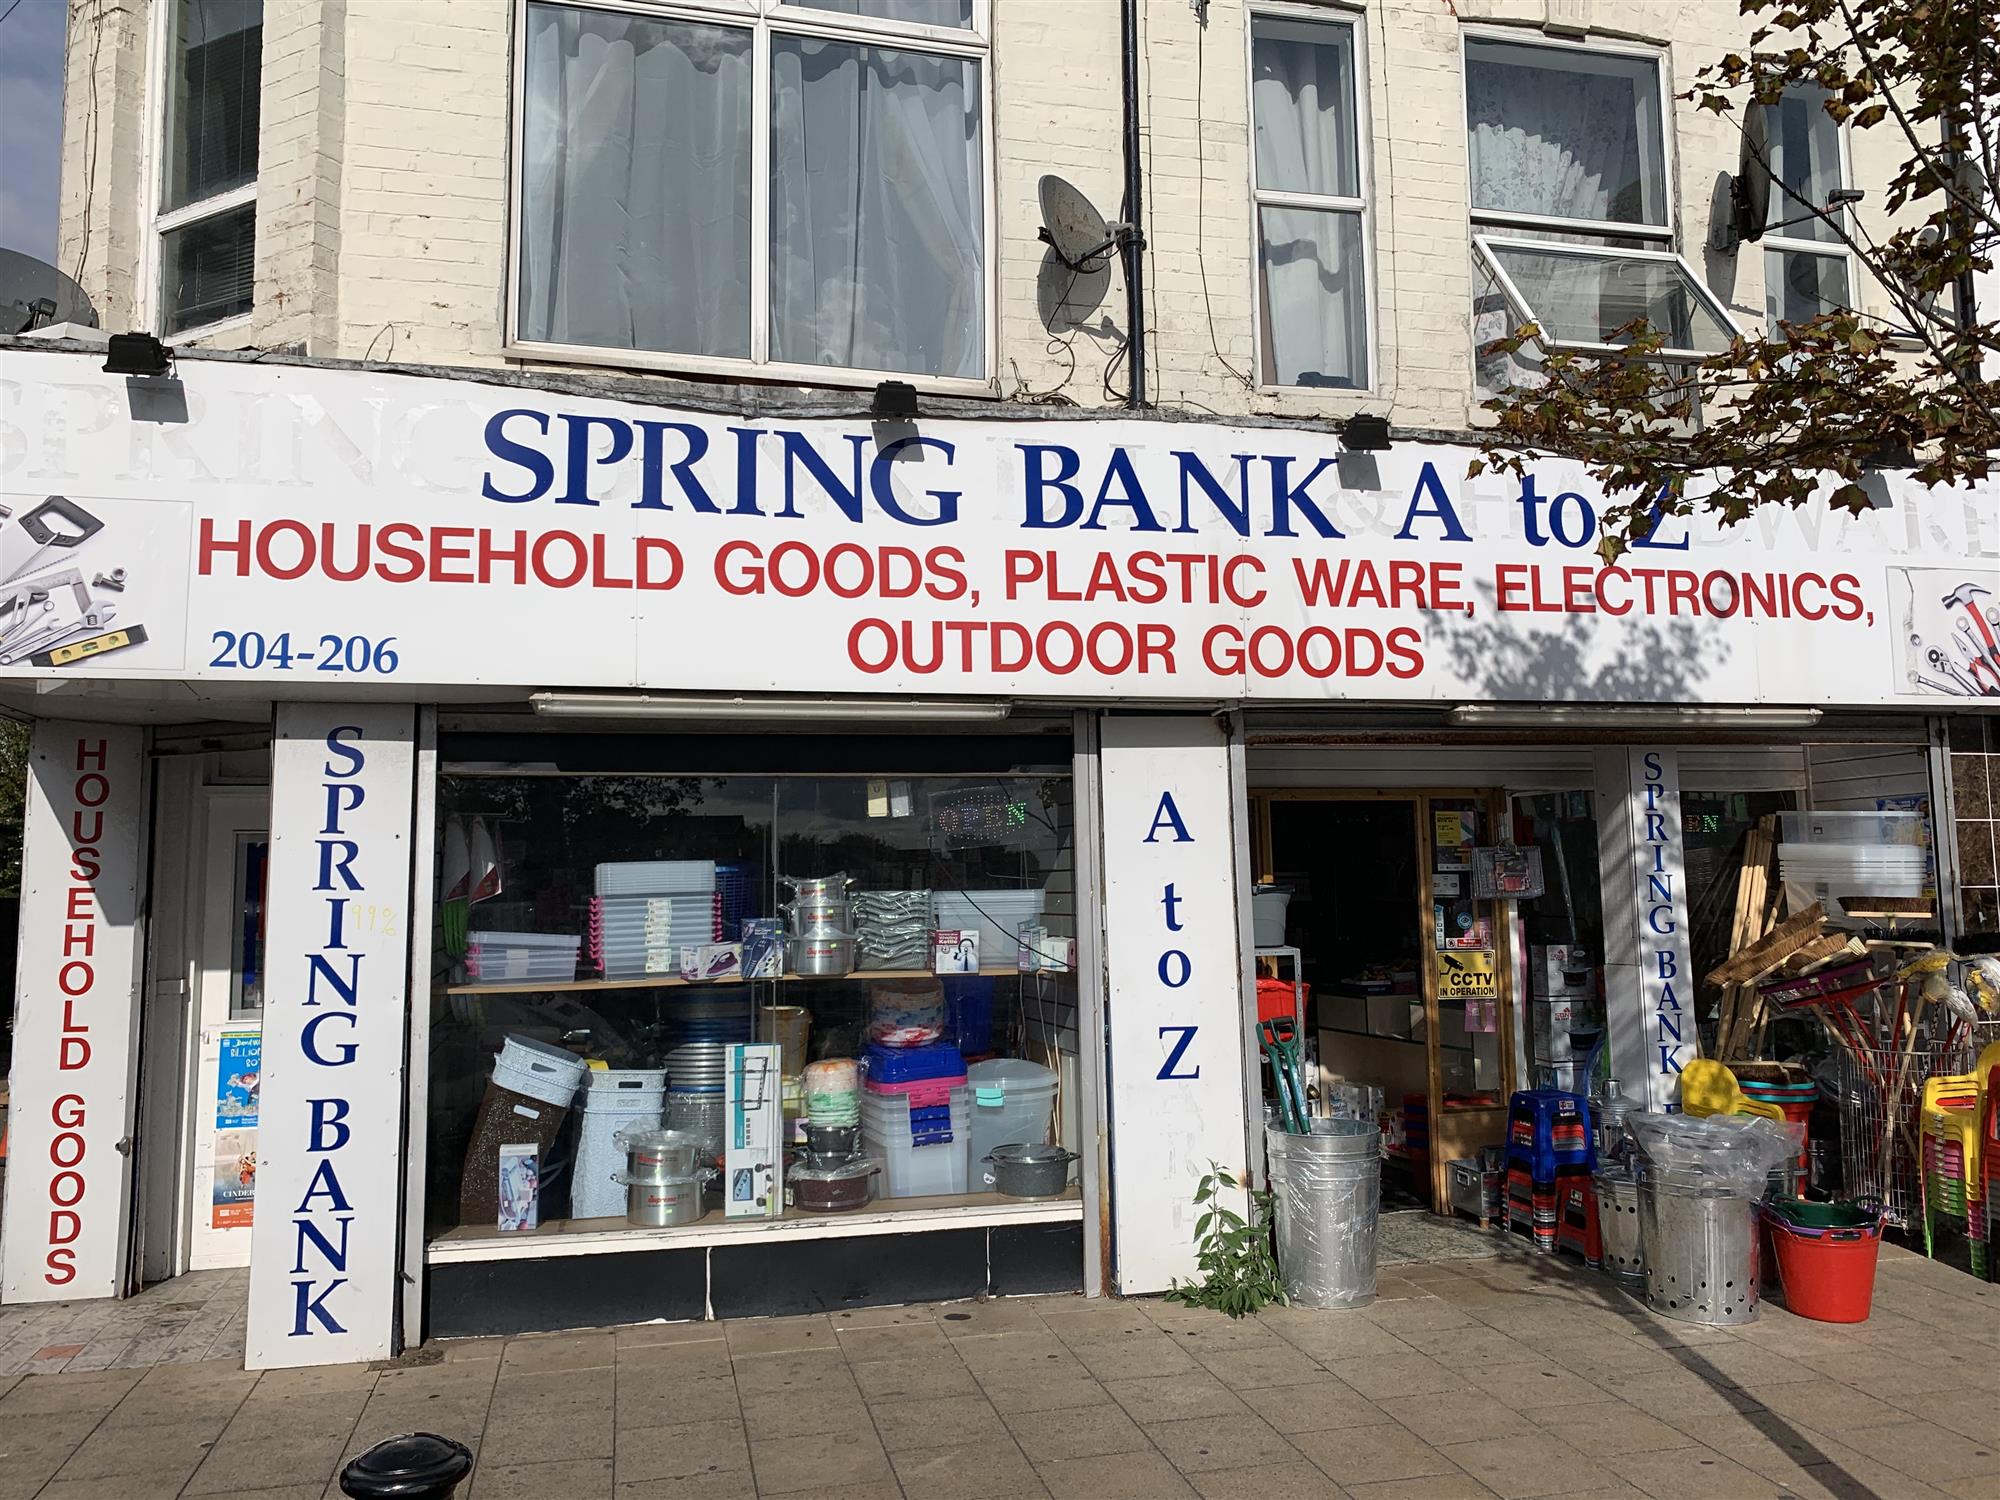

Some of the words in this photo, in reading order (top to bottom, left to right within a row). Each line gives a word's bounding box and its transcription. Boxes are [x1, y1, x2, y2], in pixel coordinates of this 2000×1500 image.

[482, 408, 963, 527] SPRING
[1017, 443, 1346, 540] BANK
[1395, 461, 1473, 542] A
[1517, 476, 1597, 549] to
[198, 517, 685, 591] HOUSEHOLD
[713, 539, 981, 608] GOODS,
[1005, 549, 1268, 608] PLASTIC
[1290, 557, 1475, 618] WARE,
[1495, 563, 1874, 627] ELECTRONICS,
[209, 630, 399, 673] 204-206
[847, 617, 1177, 676] OUTDOOR
[1201, 623, 1425, 680] GOODS
[1143, 791, 1196, 844] A
[1644, 751, 1676, 935] SPRING
[58, 739, 110, 1071] HOUSEHOLD
[300, 725, 366, 1068] SPRING
[1440, 987, 1448, 996] IN
[1450, 986, 1494, 996] OPERATION
[1450, 972, 1493, 986] CCTV
[1656, 949, 1683, 1075] BANK
[1155, 1025, 1201, 1081] Z
[44, 1093, 87, 1286] GOODS
[287, 1098, 355, 1338] BANK
